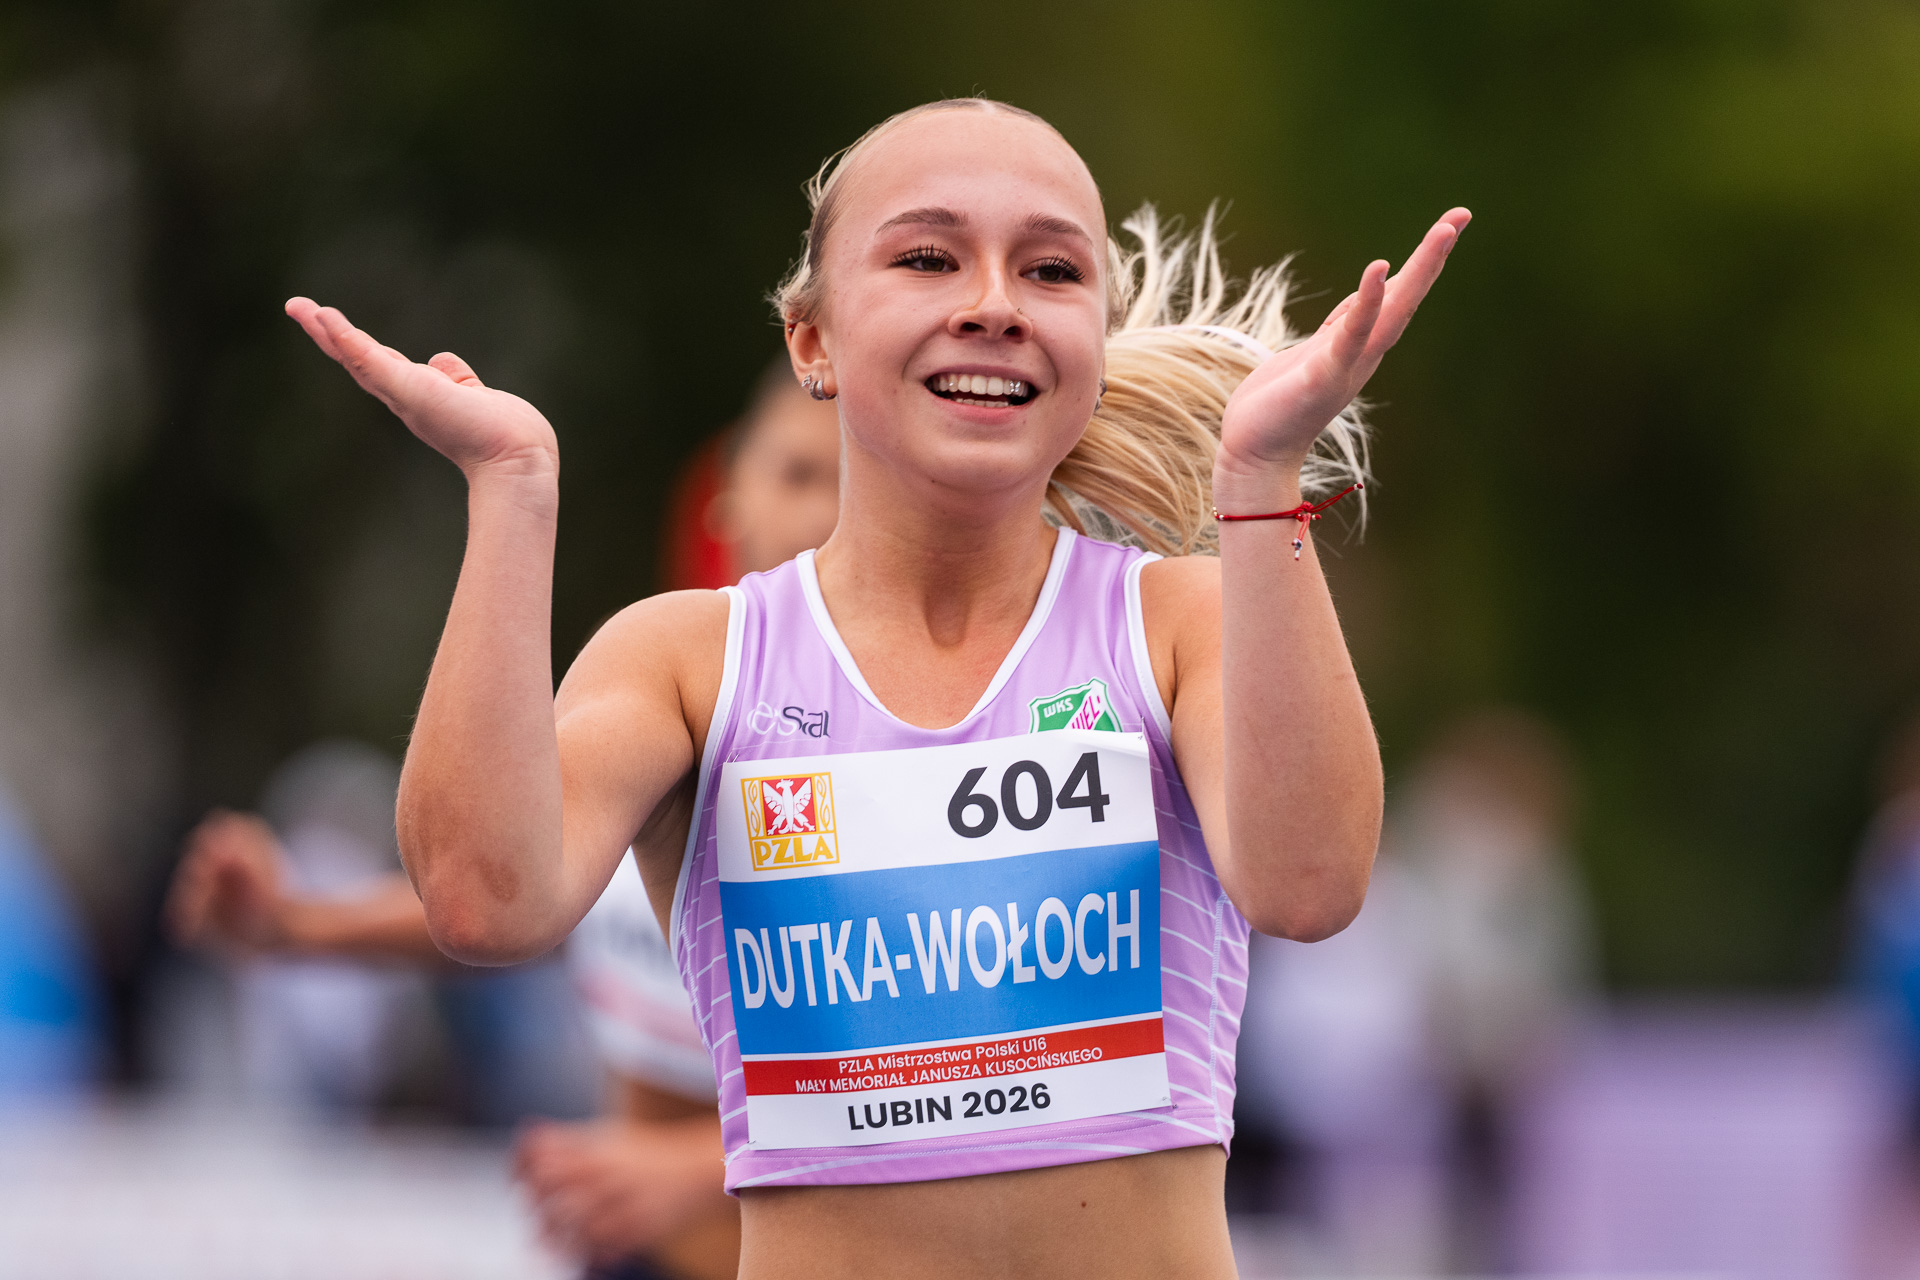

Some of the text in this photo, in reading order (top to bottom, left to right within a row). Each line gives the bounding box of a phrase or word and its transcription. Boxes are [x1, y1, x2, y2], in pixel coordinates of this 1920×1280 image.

[1043, 697, 1074, 718] WKS
[947, 751, 1110, 838] 604
[754, 835, 834, 866] PZLA
[734, 889, 1141, 1009] DUTKA-WOŁOCH
[795, 1047, 1103, 1092] MAŁY MEMORIAŁ JANUSZA KUSOCIŃSKIEGO
[839, 1037, 1047, 1074] PZLA Mistrzostwa Polski U16
[848, 1083, 1051, 1130] LUBIN 2026
